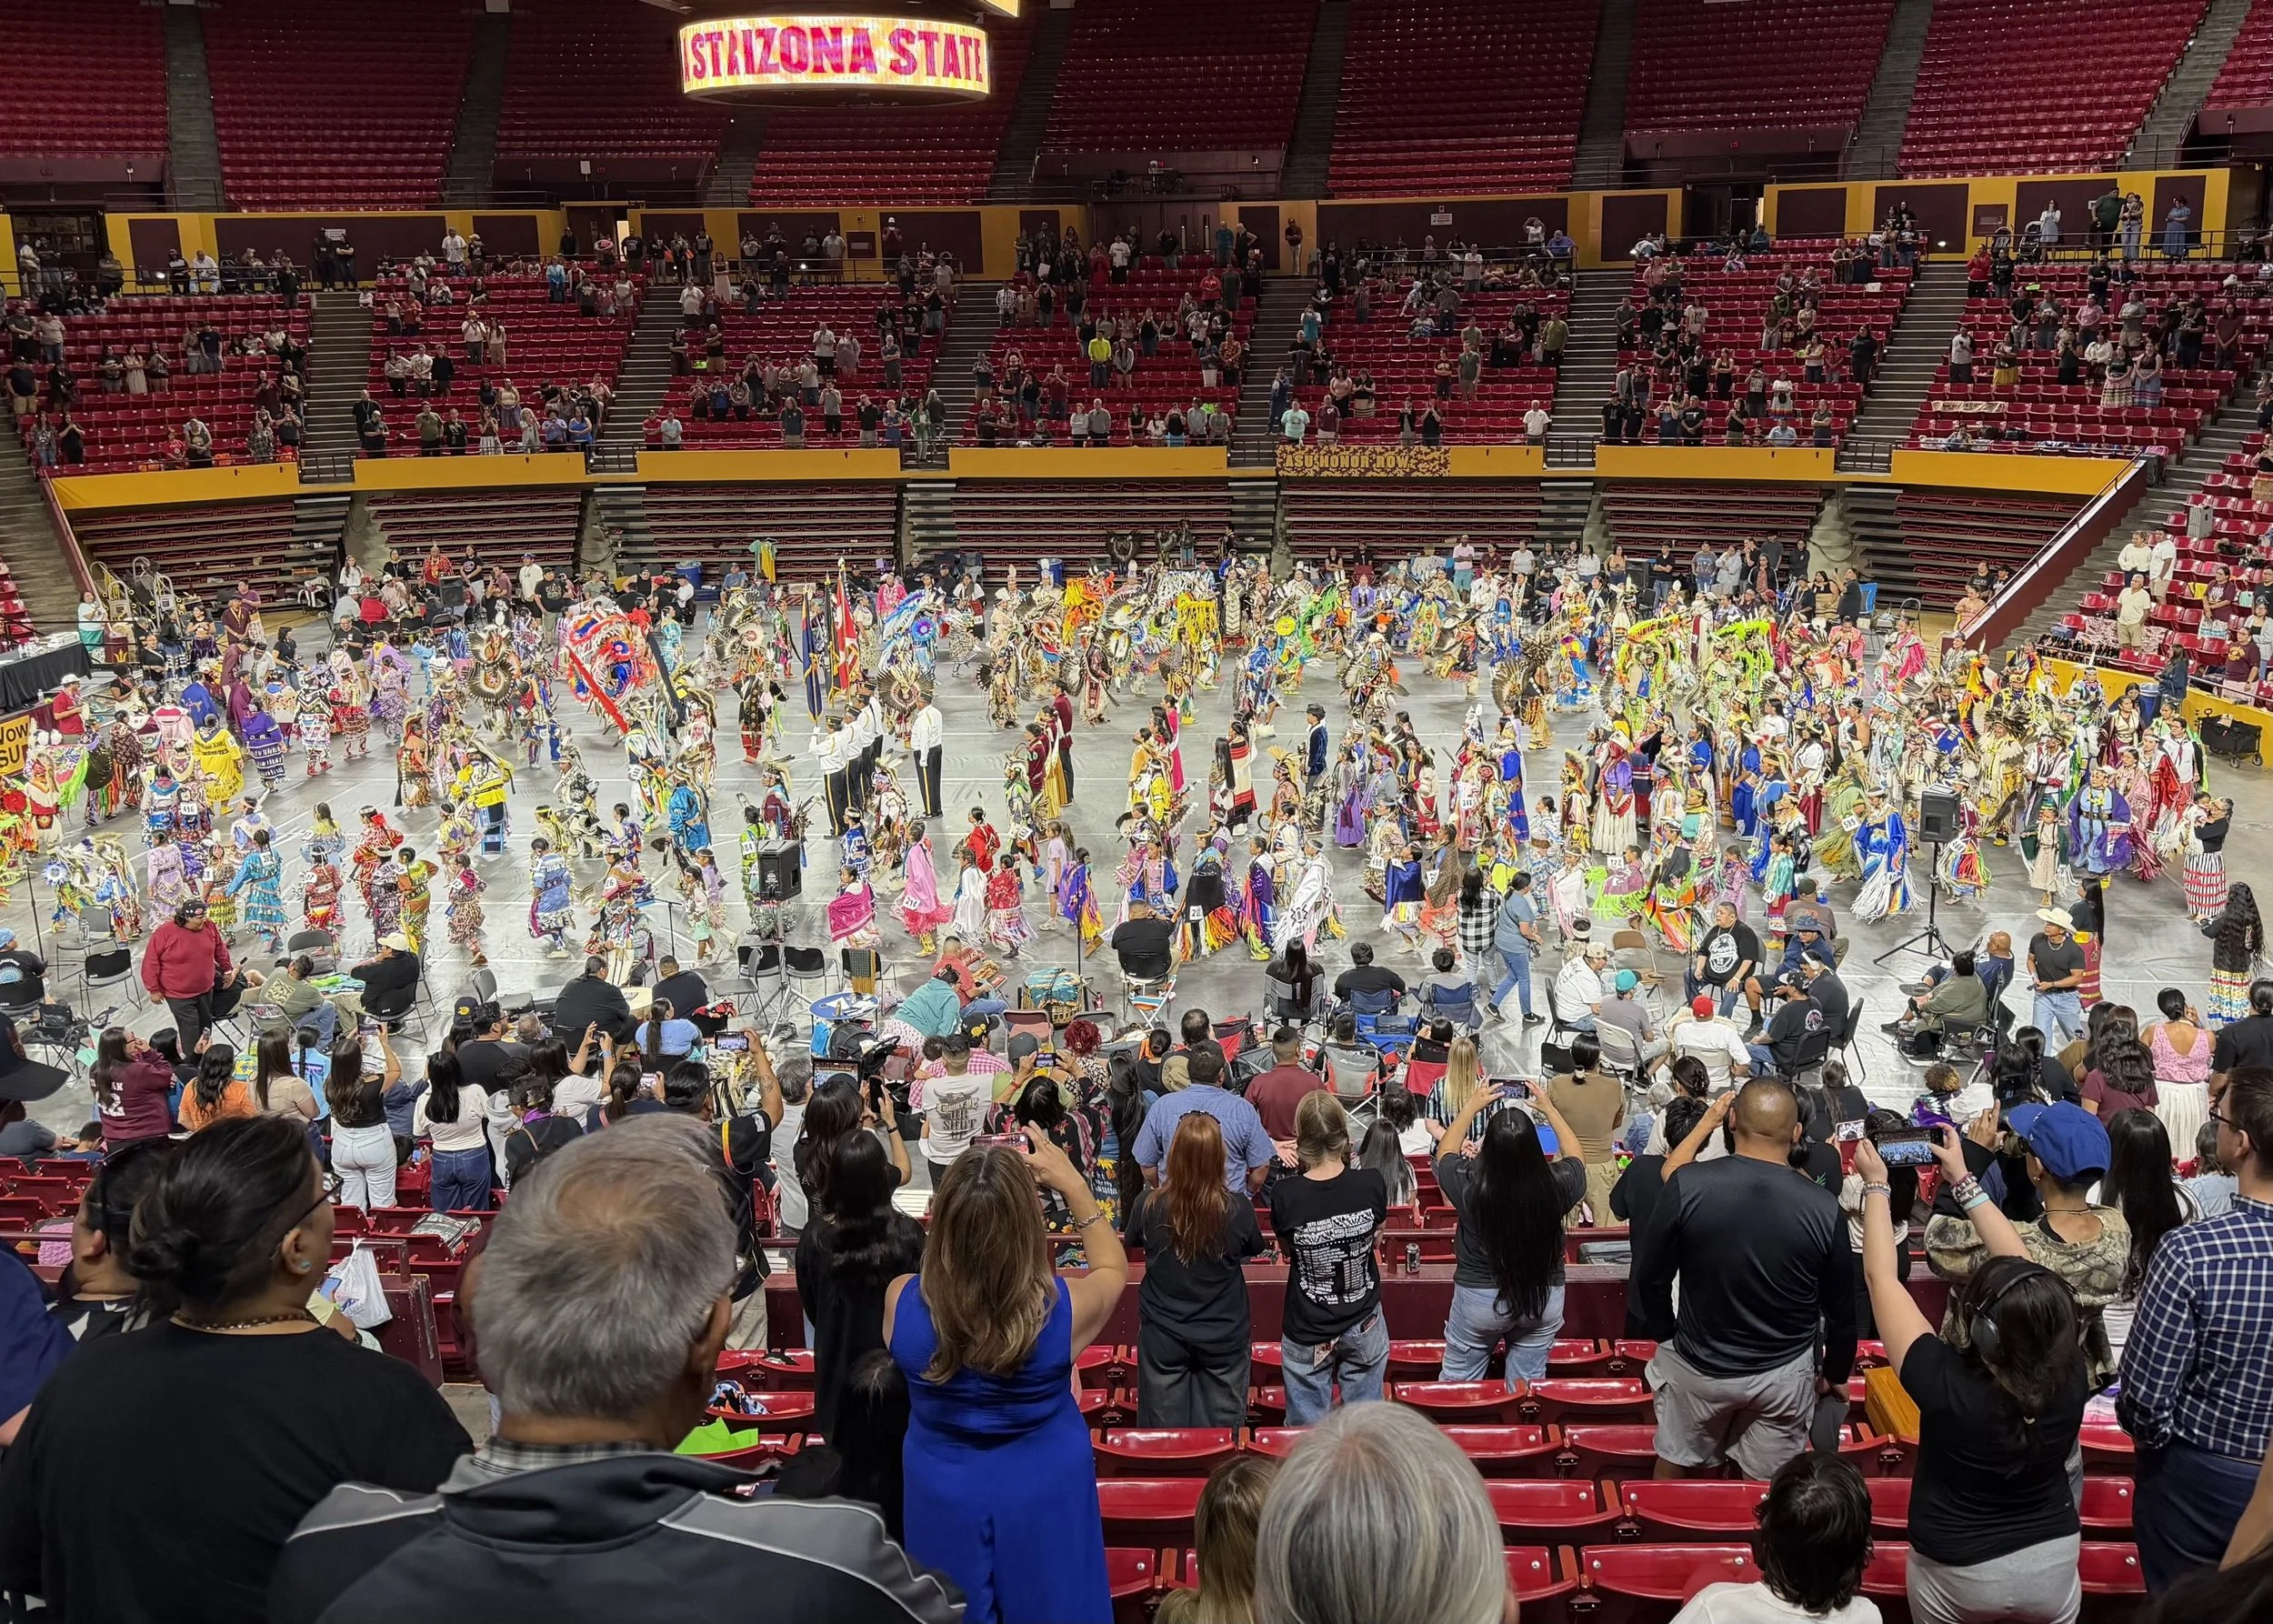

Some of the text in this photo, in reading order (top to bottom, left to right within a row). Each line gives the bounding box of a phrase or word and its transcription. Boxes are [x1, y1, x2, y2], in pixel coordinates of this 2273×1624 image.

[1285, 455, 1408, 469] ASU HONOR ROW
